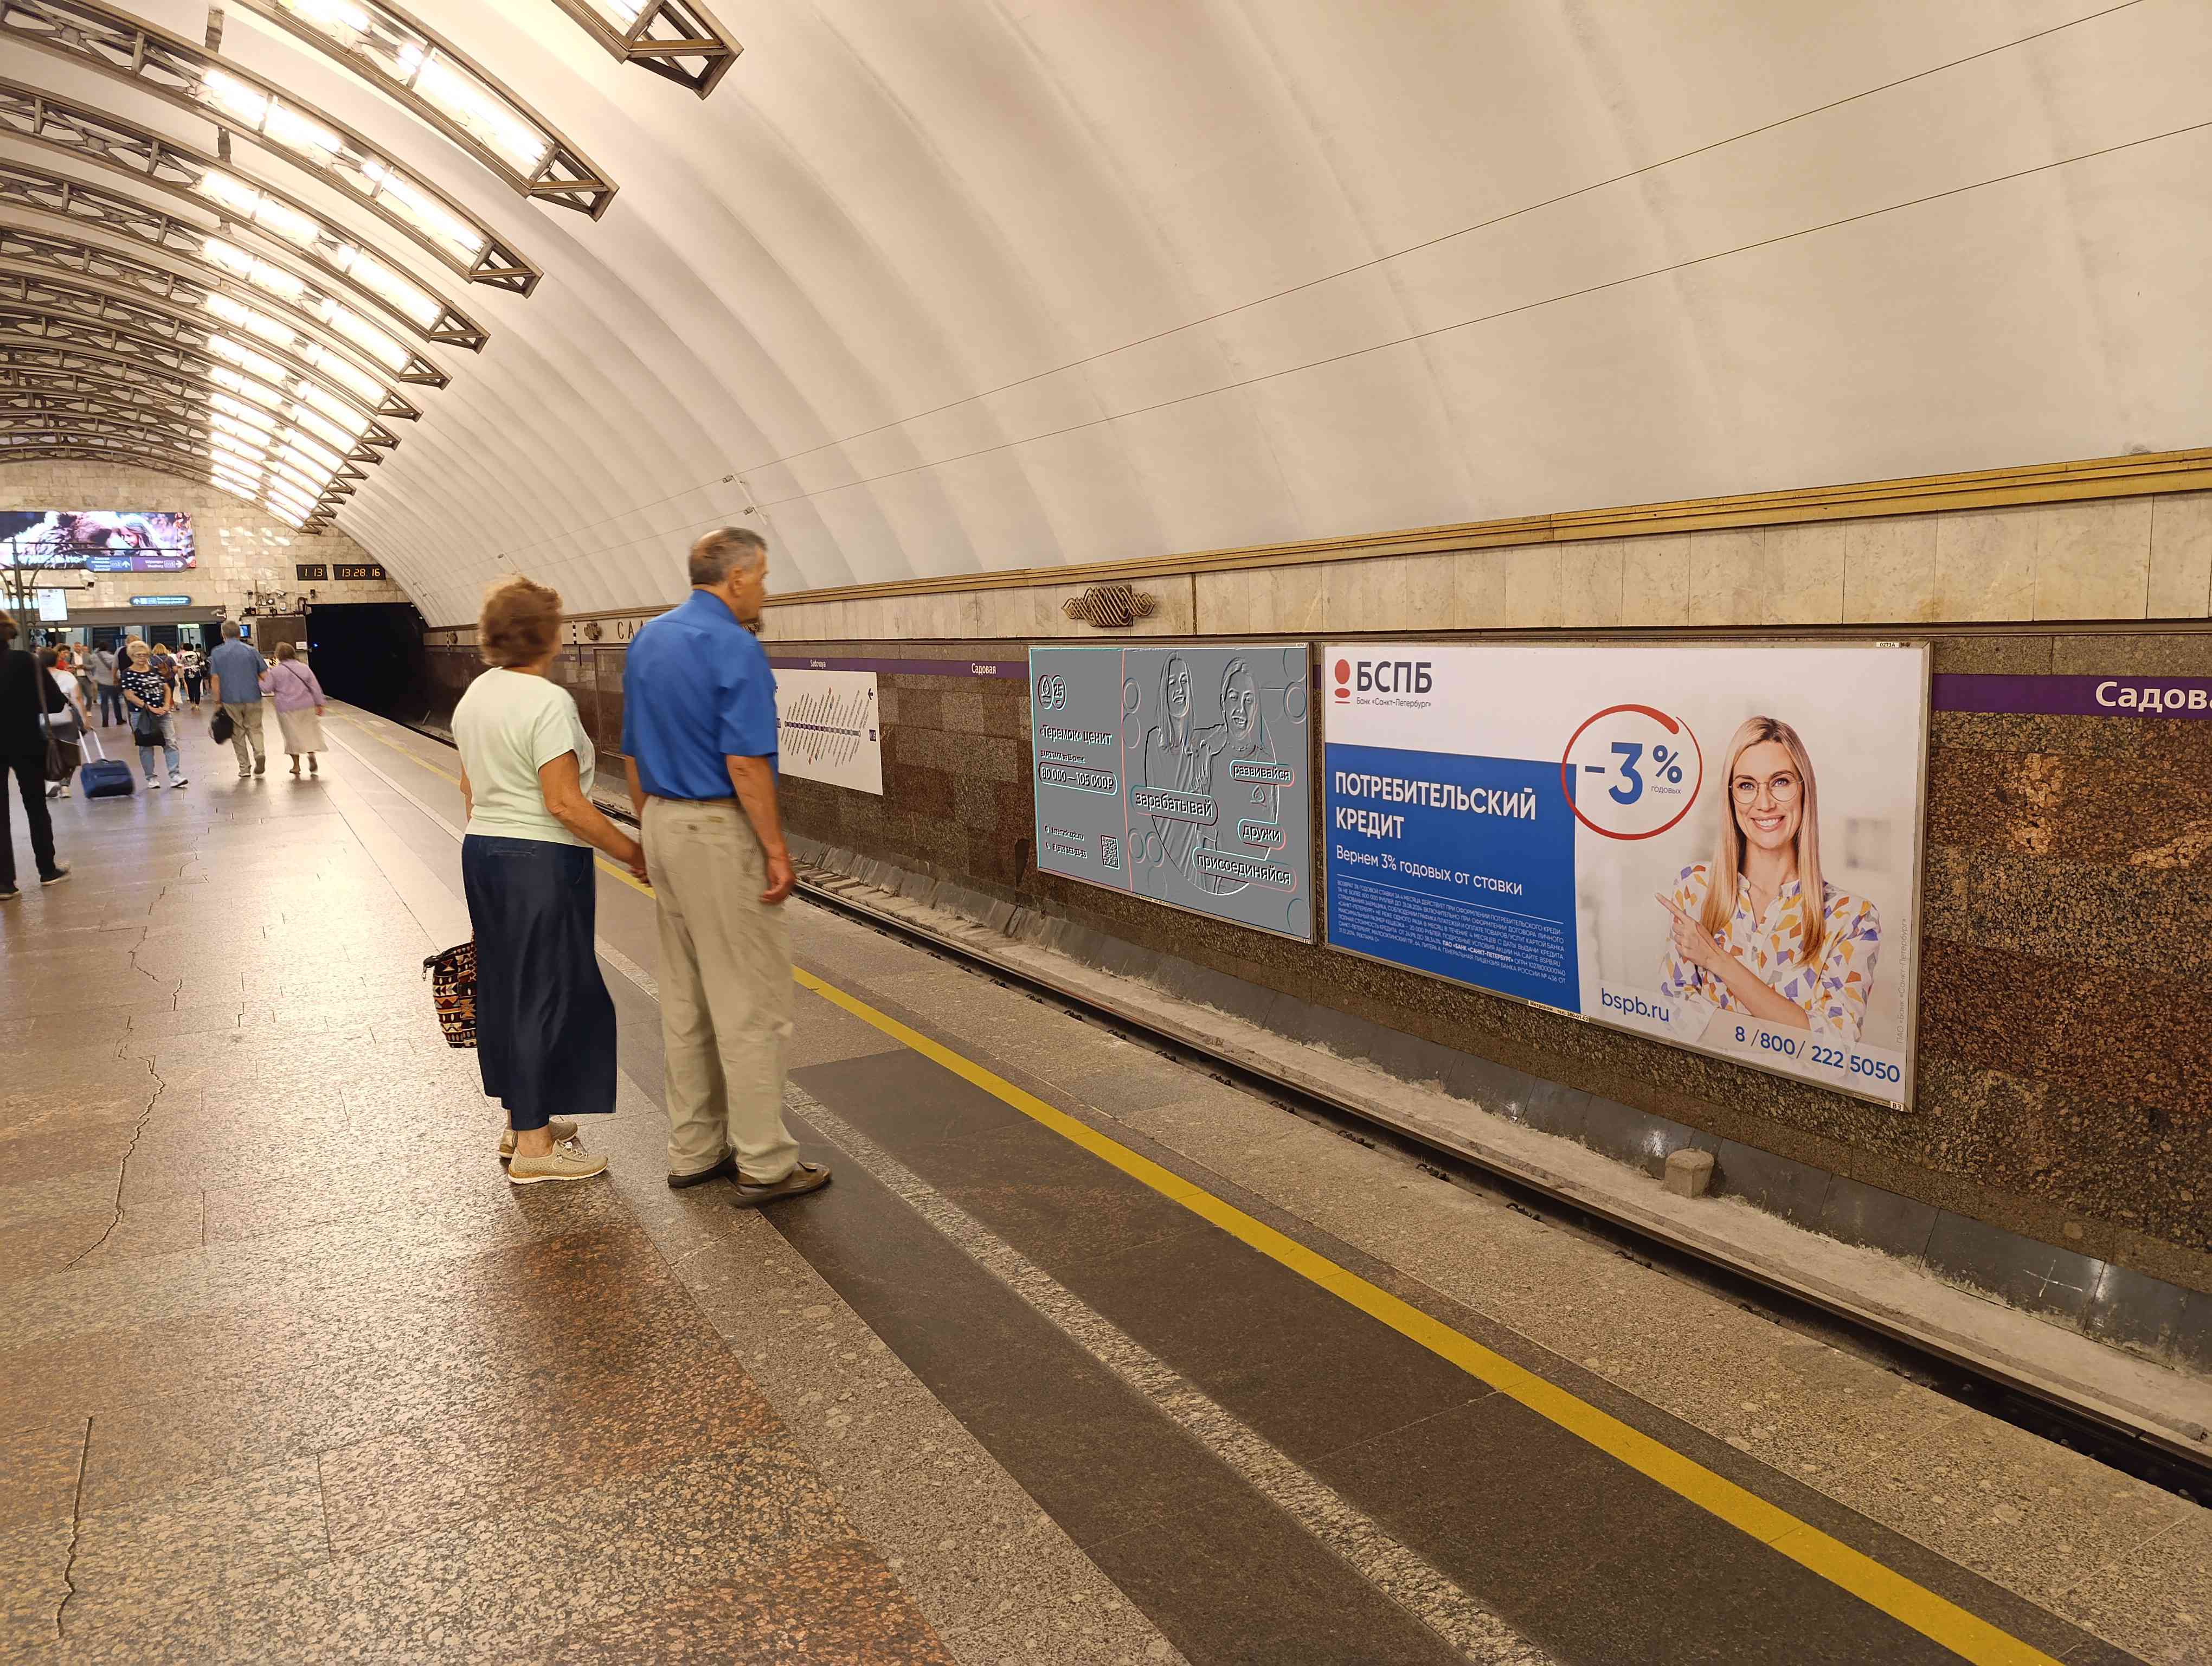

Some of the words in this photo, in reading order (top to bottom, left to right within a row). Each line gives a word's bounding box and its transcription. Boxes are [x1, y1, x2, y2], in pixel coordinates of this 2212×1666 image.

[971, 663, 996, 676] Садовая
[1357, 661, 1432, 694] БСПБ
[1054, 684, 1063, 699] 25
[1356, 697, 1370, 706] Банк
[1372, 697, 1431, 709] «Санкт-Петербург»
[2095, 681, 2212, 713] Садов
[1040, 724, 1082, 742] «Теремок»
[1083, 731, 1113, 745] ценит
[1041, 766, 1051, 781] 80
[1052, 770, 1066, 783] 000
[1076, 772, 1090, 786] 105
[1233, 765, 1291, 781] развивайся
[1335, 771, 1536, 821] ПОТРЕБИТЕЛЬСКИЙ
[1651, 786, 1681, 795] годовых
[1135, 792, 1213, 818] зарабатывай
[1243, 824, 1281, 843] дружи
[1336, 806, 1404, 839] КРЕДИТ
[1197, 854, 1291, 886] присоединяйся
[1336, 844, 1379, 867] Вернем
[1381, 853, 1397, 871] 3%
[1400, 861, 1451, 882] годовых
[1455, 872, 1470, 885] от
[1474, 875, 1523, 896] ставки
[1898, 918, 1909, 998] «Санкт-Петербург»
[1601, 988, 1669, 1023] bspb.ru
[1897, 1002, 1906, 1024] «Банк
[1896, 1026, 1905, 1044] ПАО
[1735, 1026, 1745, 1042] 8
[1811, 1045, 1844, 1069] 222
[1849, 1055, 1900, 1084] 5050
